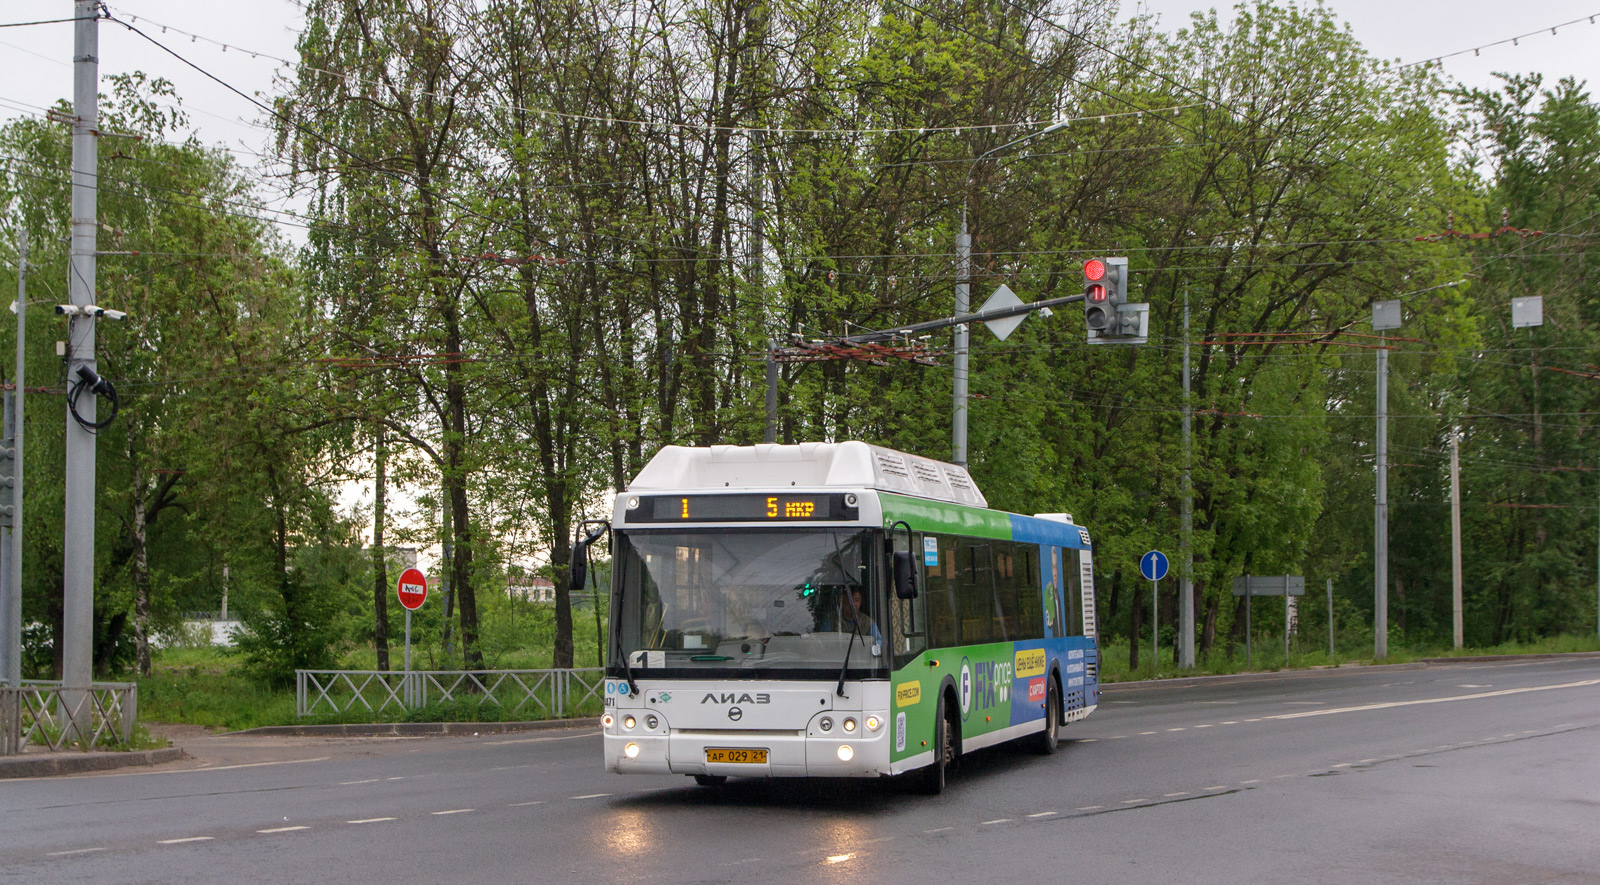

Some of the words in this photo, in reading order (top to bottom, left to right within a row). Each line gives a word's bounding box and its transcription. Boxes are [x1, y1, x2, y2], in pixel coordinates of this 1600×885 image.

[681, 498, 689, 518] 1
[767, 497, 778, 517] 5
[785, 502, 814, 517] МКР
[636, 652, 648, 668] 1
[962, 672, 969, 706] F
[700, 693, 771, 704] ЛИАЗ
[712, 752, 724, 761] АР
[728, 751, 748, 761] 029
[753, 751, 763, 759] 21
